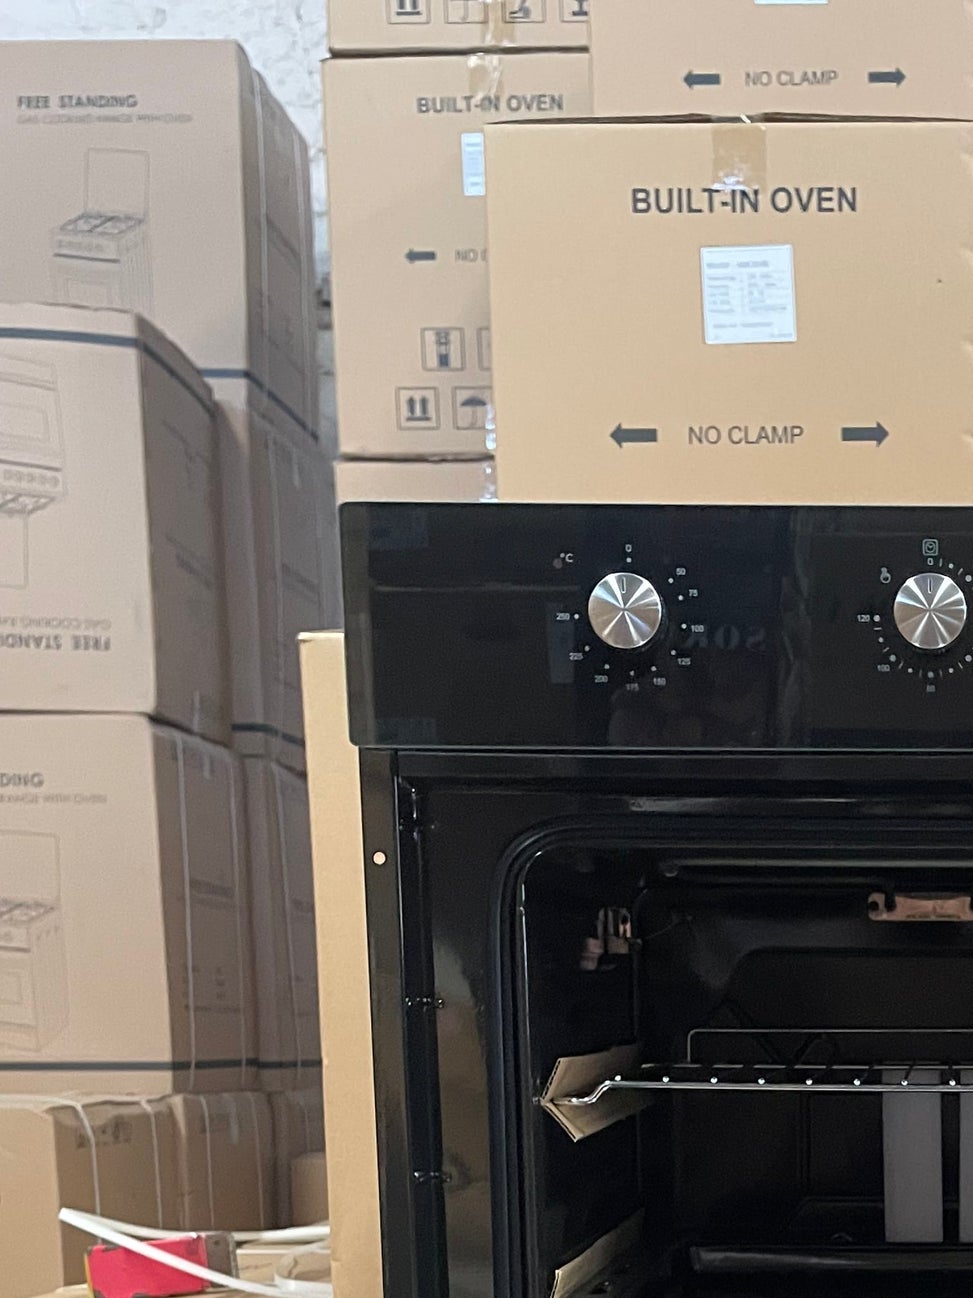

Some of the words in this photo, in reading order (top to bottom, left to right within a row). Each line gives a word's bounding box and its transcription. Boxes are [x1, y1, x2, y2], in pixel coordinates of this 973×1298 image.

[744, 70, 773, 87] NO
[776, 70, 840, 87] CLAMP
[507, 94, 564, 112] OVEN
[631, 187, 760, 213] BUILT-IN
[770, 187, 858, 212] OVEN
[688, 426, 721, 444] NO
[728, 425, 804, 444] CLAMP
[691, 625, 705, 633] 100
